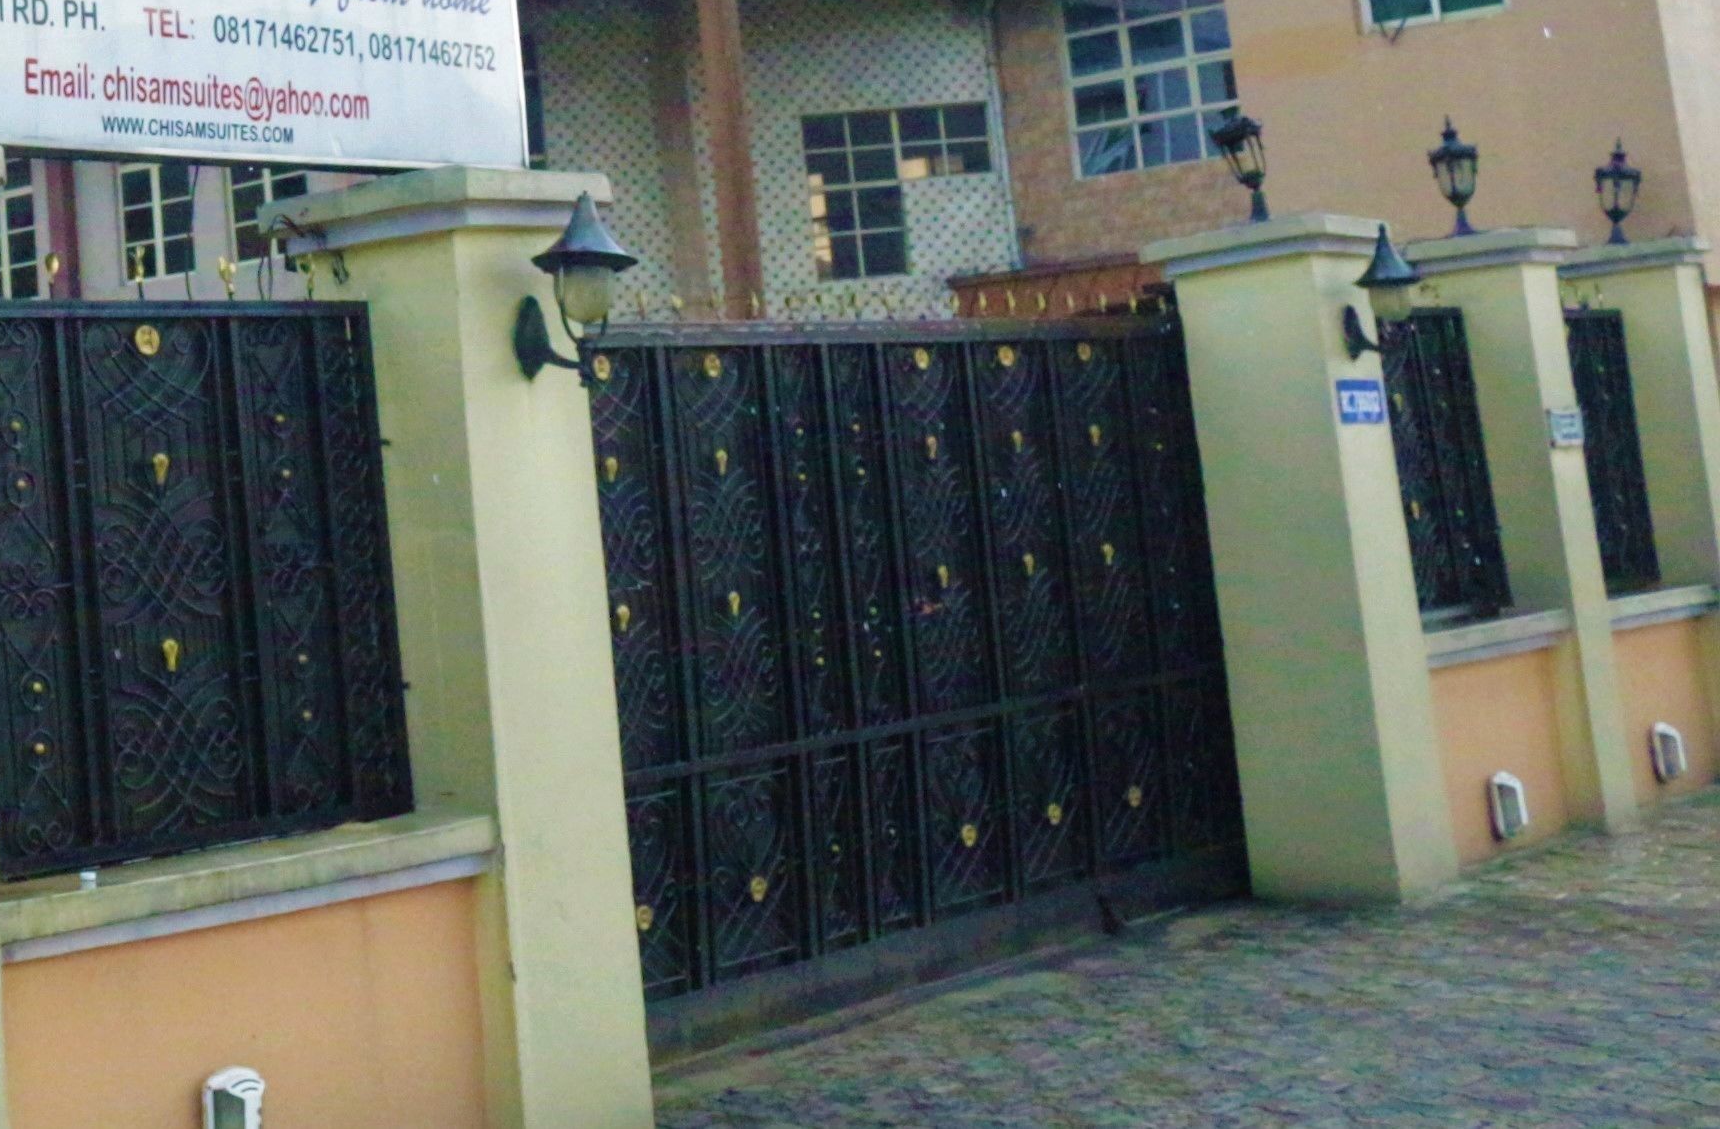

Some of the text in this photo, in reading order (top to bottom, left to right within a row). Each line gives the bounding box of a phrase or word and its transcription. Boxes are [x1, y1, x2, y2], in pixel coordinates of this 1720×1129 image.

[142, 7, 196, 40] TEL:
[24, 57, 370, 121] Email: chisamsuites@yahoo.com
[101, 115, 294, 144] WWW.CHISAMSUITES.COM
